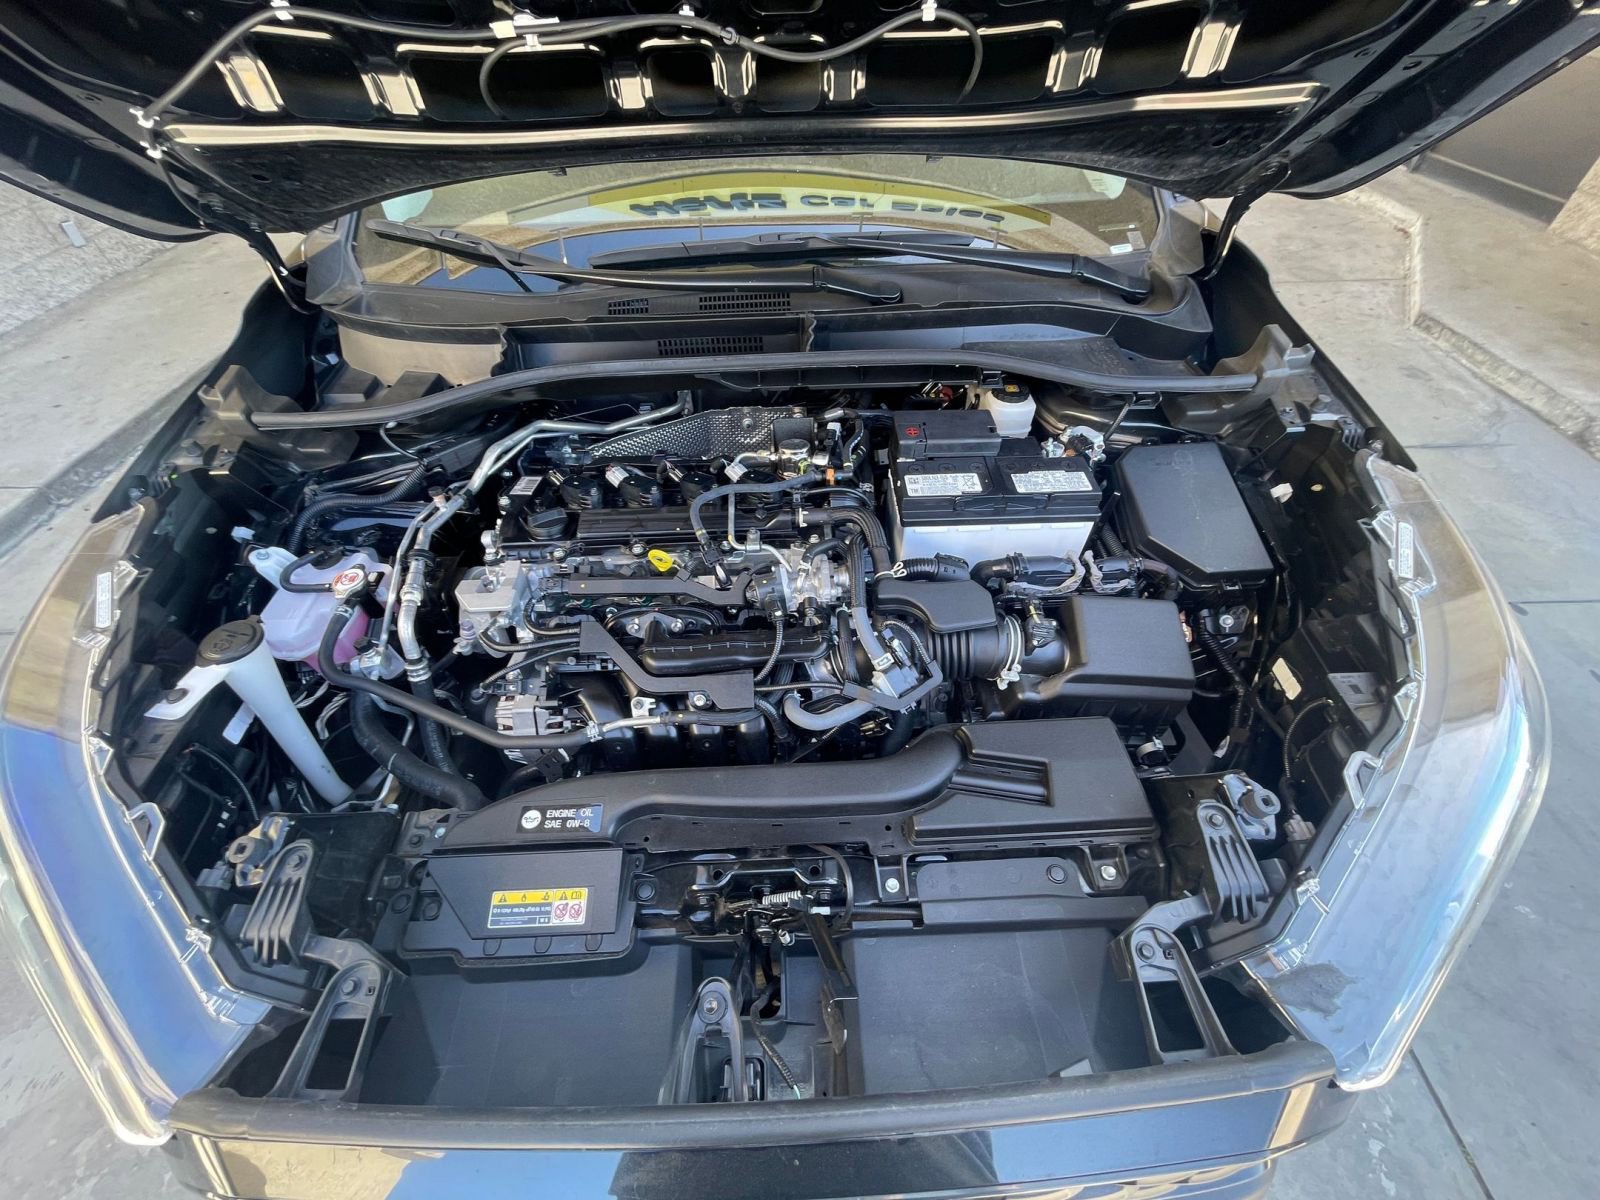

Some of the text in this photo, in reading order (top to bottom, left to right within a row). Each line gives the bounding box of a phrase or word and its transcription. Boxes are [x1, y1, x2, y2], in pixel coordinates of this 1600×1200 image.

[546, 808, 594, 818] ENGINE OIL
[543, 819, 562, 828] SAE
